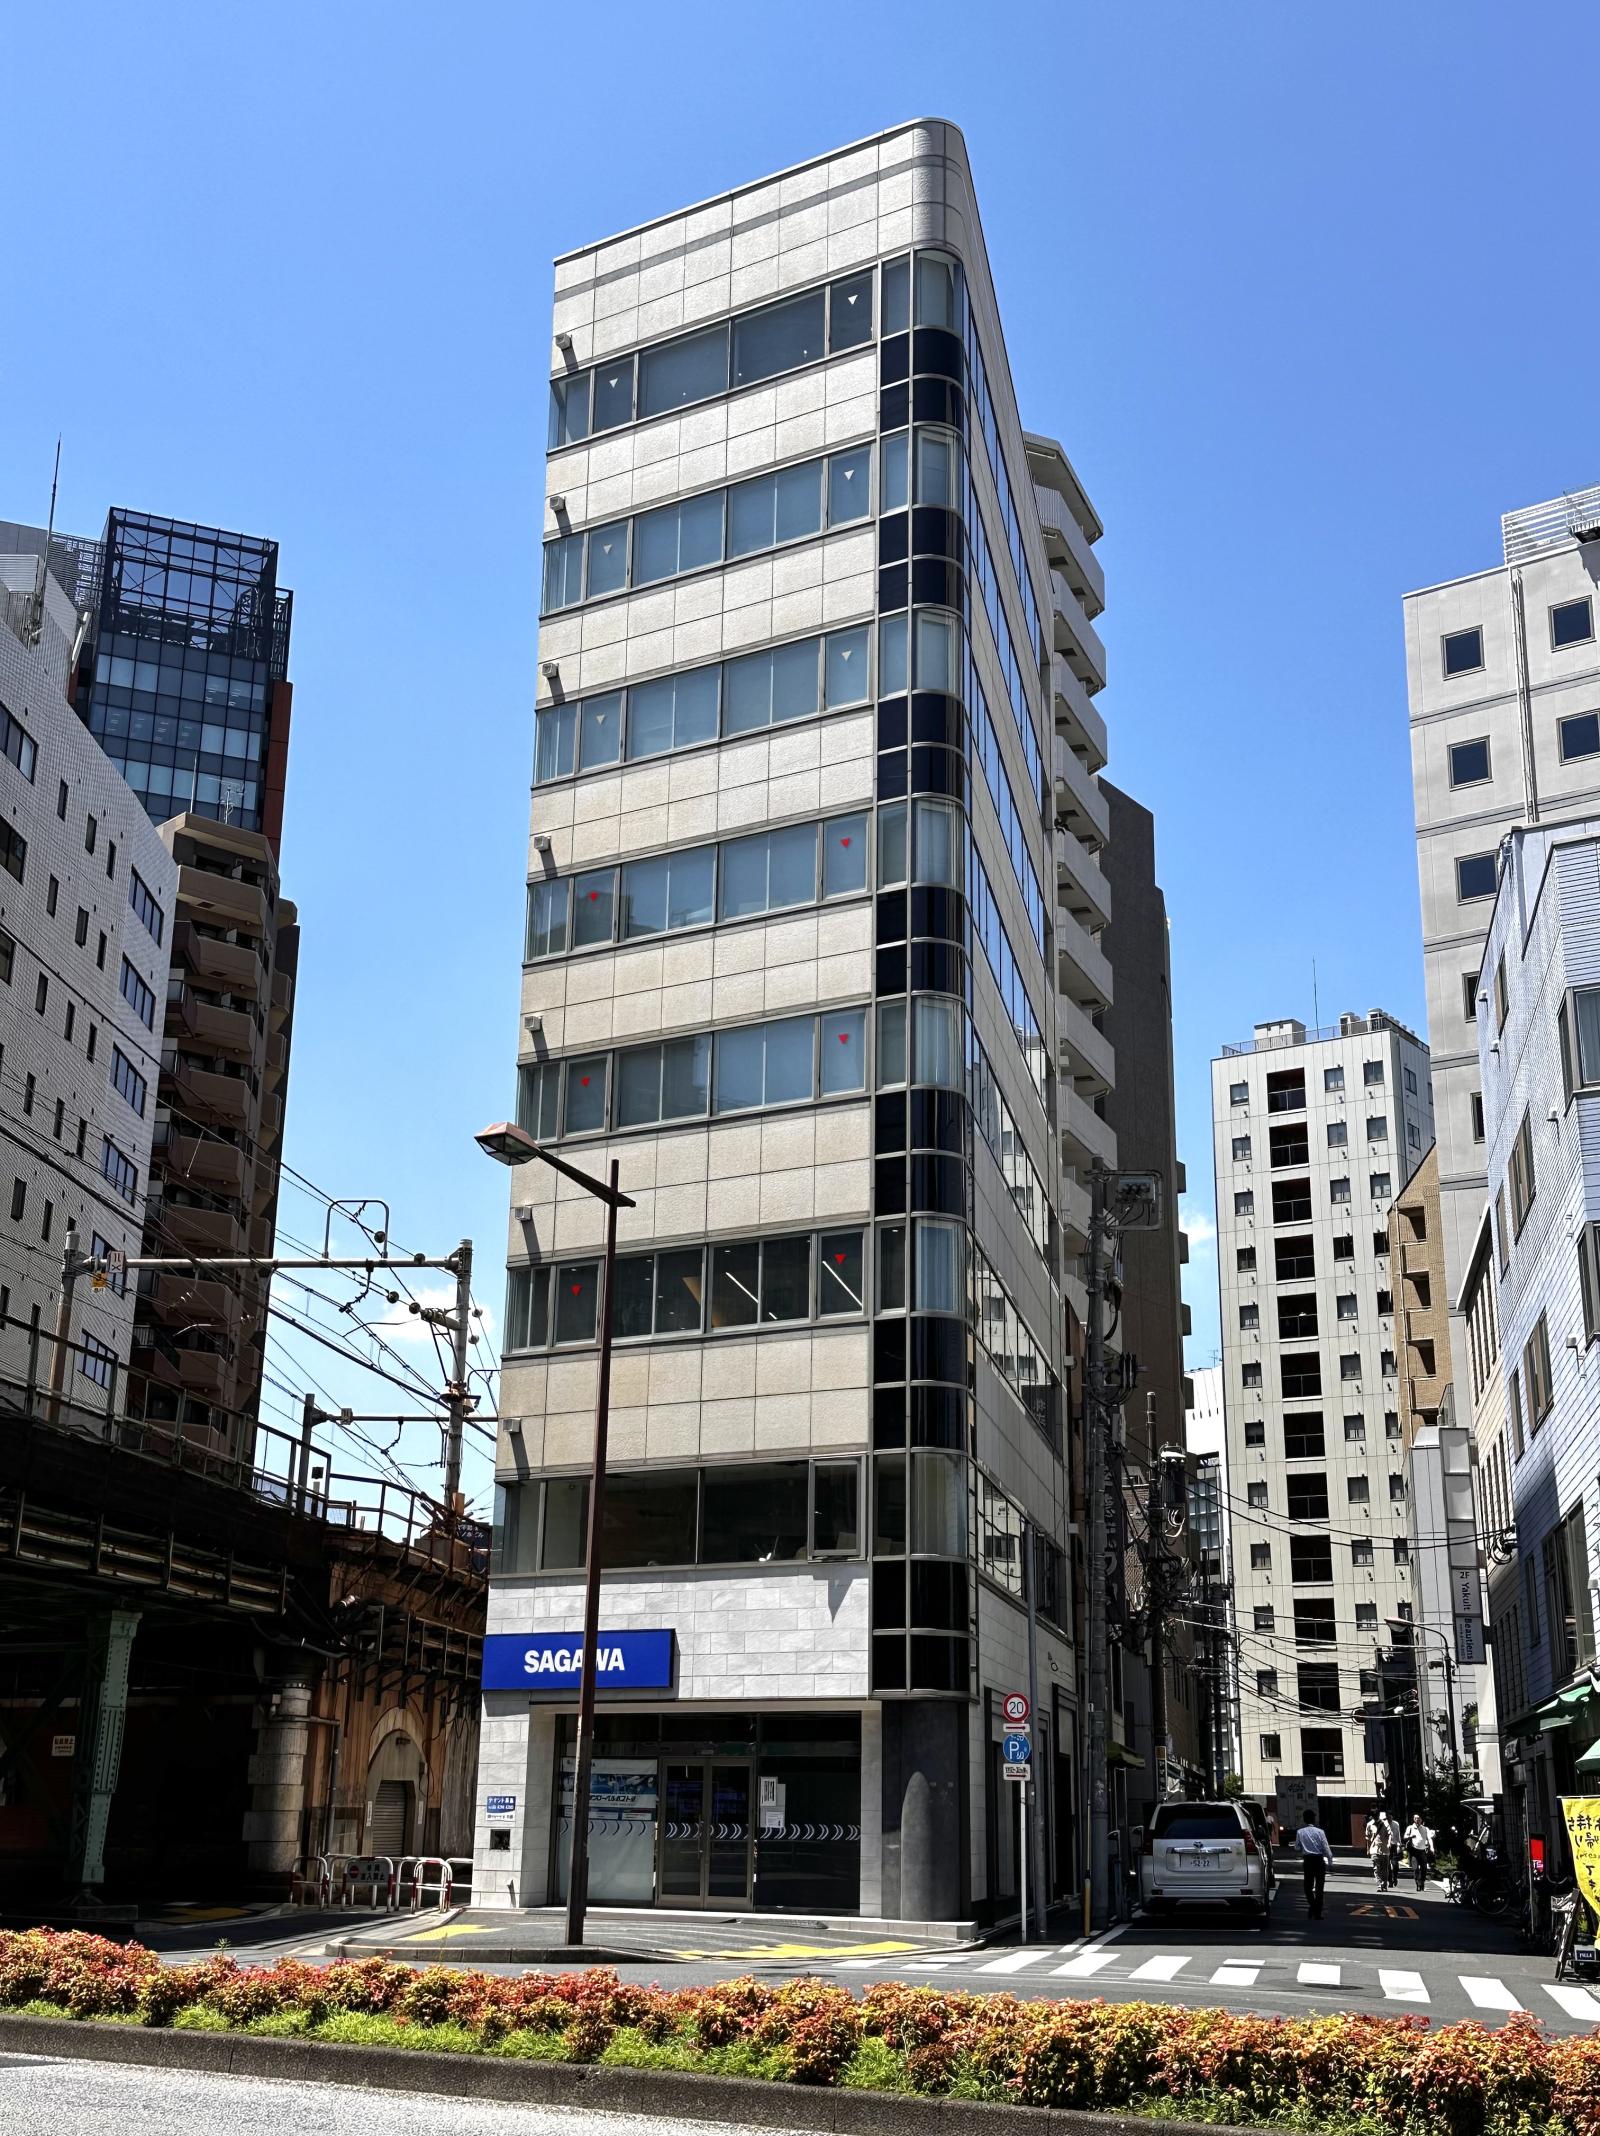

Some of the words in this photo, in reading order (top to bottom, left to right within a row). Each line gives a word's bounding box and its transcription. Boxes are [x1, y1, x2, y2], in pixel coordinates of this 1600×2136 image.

[1461, 1582, 1472, 1611] Yakult
[1009, 1702, 1024, 1714] 20
[1009, 1741, 1020, 1760] P
